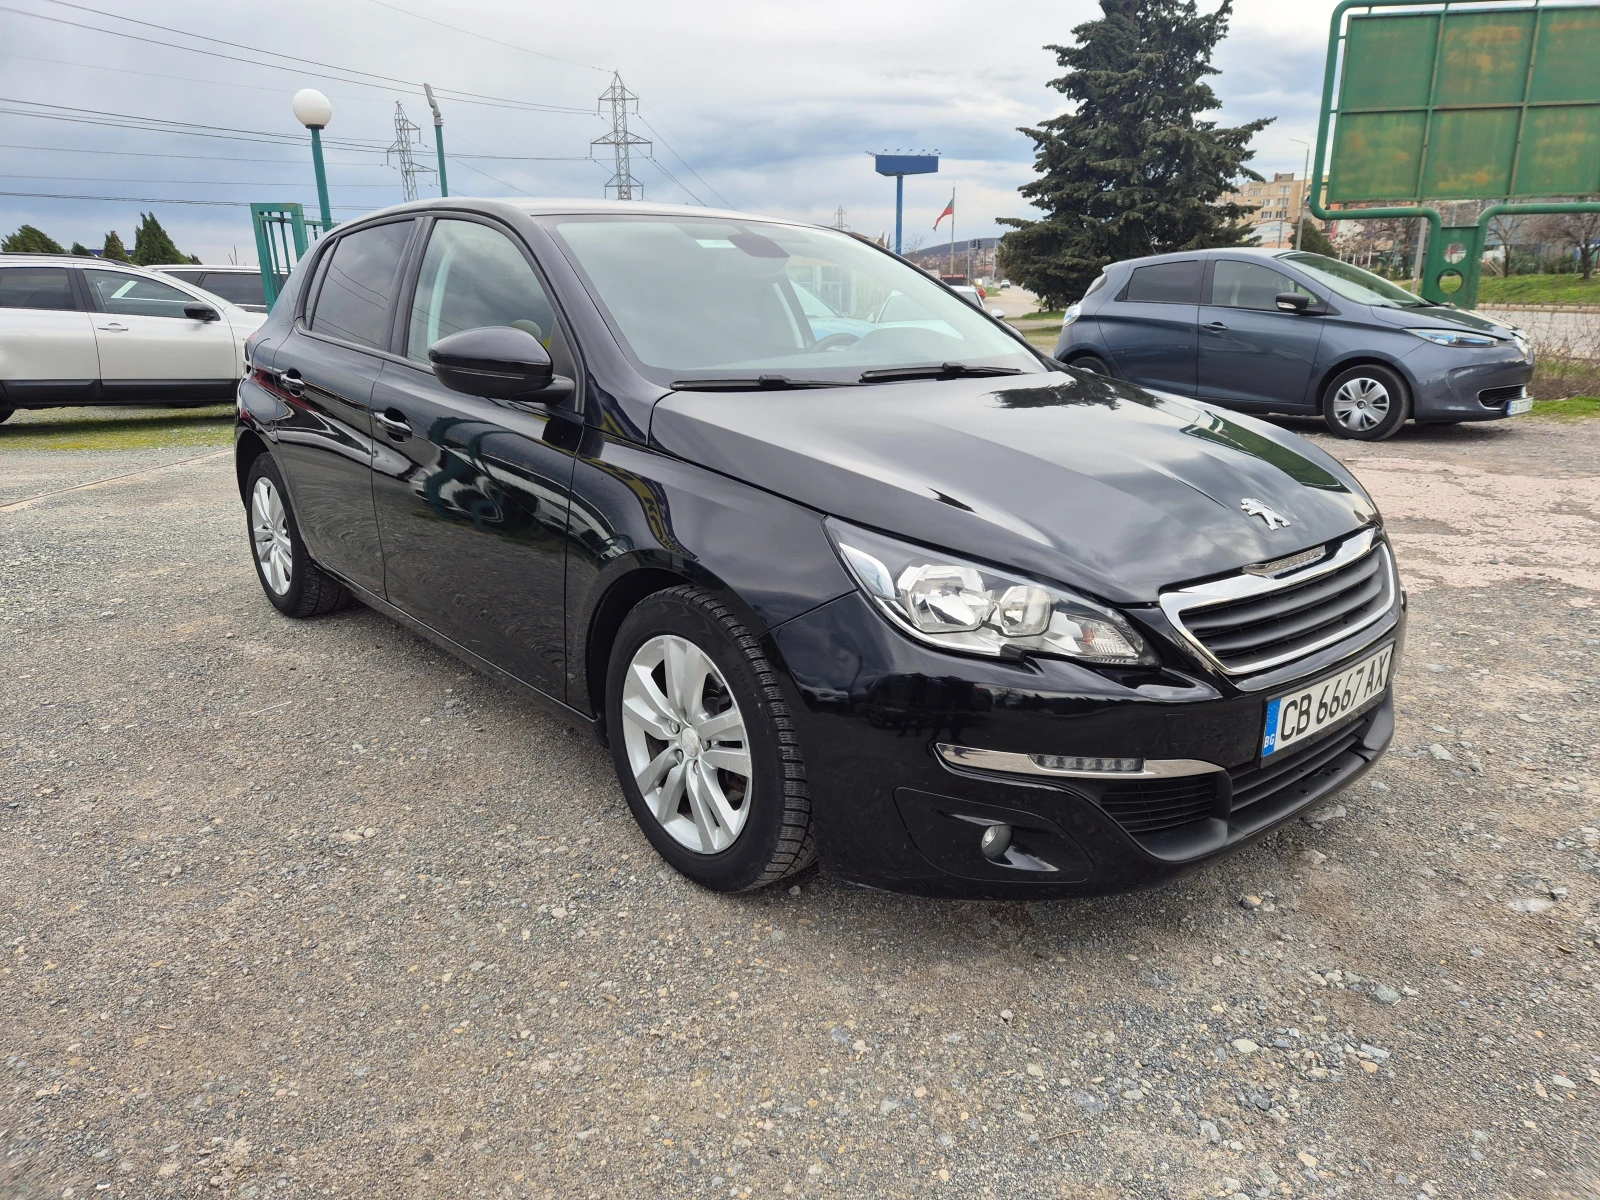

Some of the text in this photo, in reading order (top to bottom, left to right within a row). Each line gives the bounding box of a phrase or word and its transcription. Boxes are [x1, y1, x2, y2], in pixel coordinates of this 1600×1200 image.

[1281, 651, 1389, 741] CB 6667 AX
[1264, 734, 1275, 749] BG
